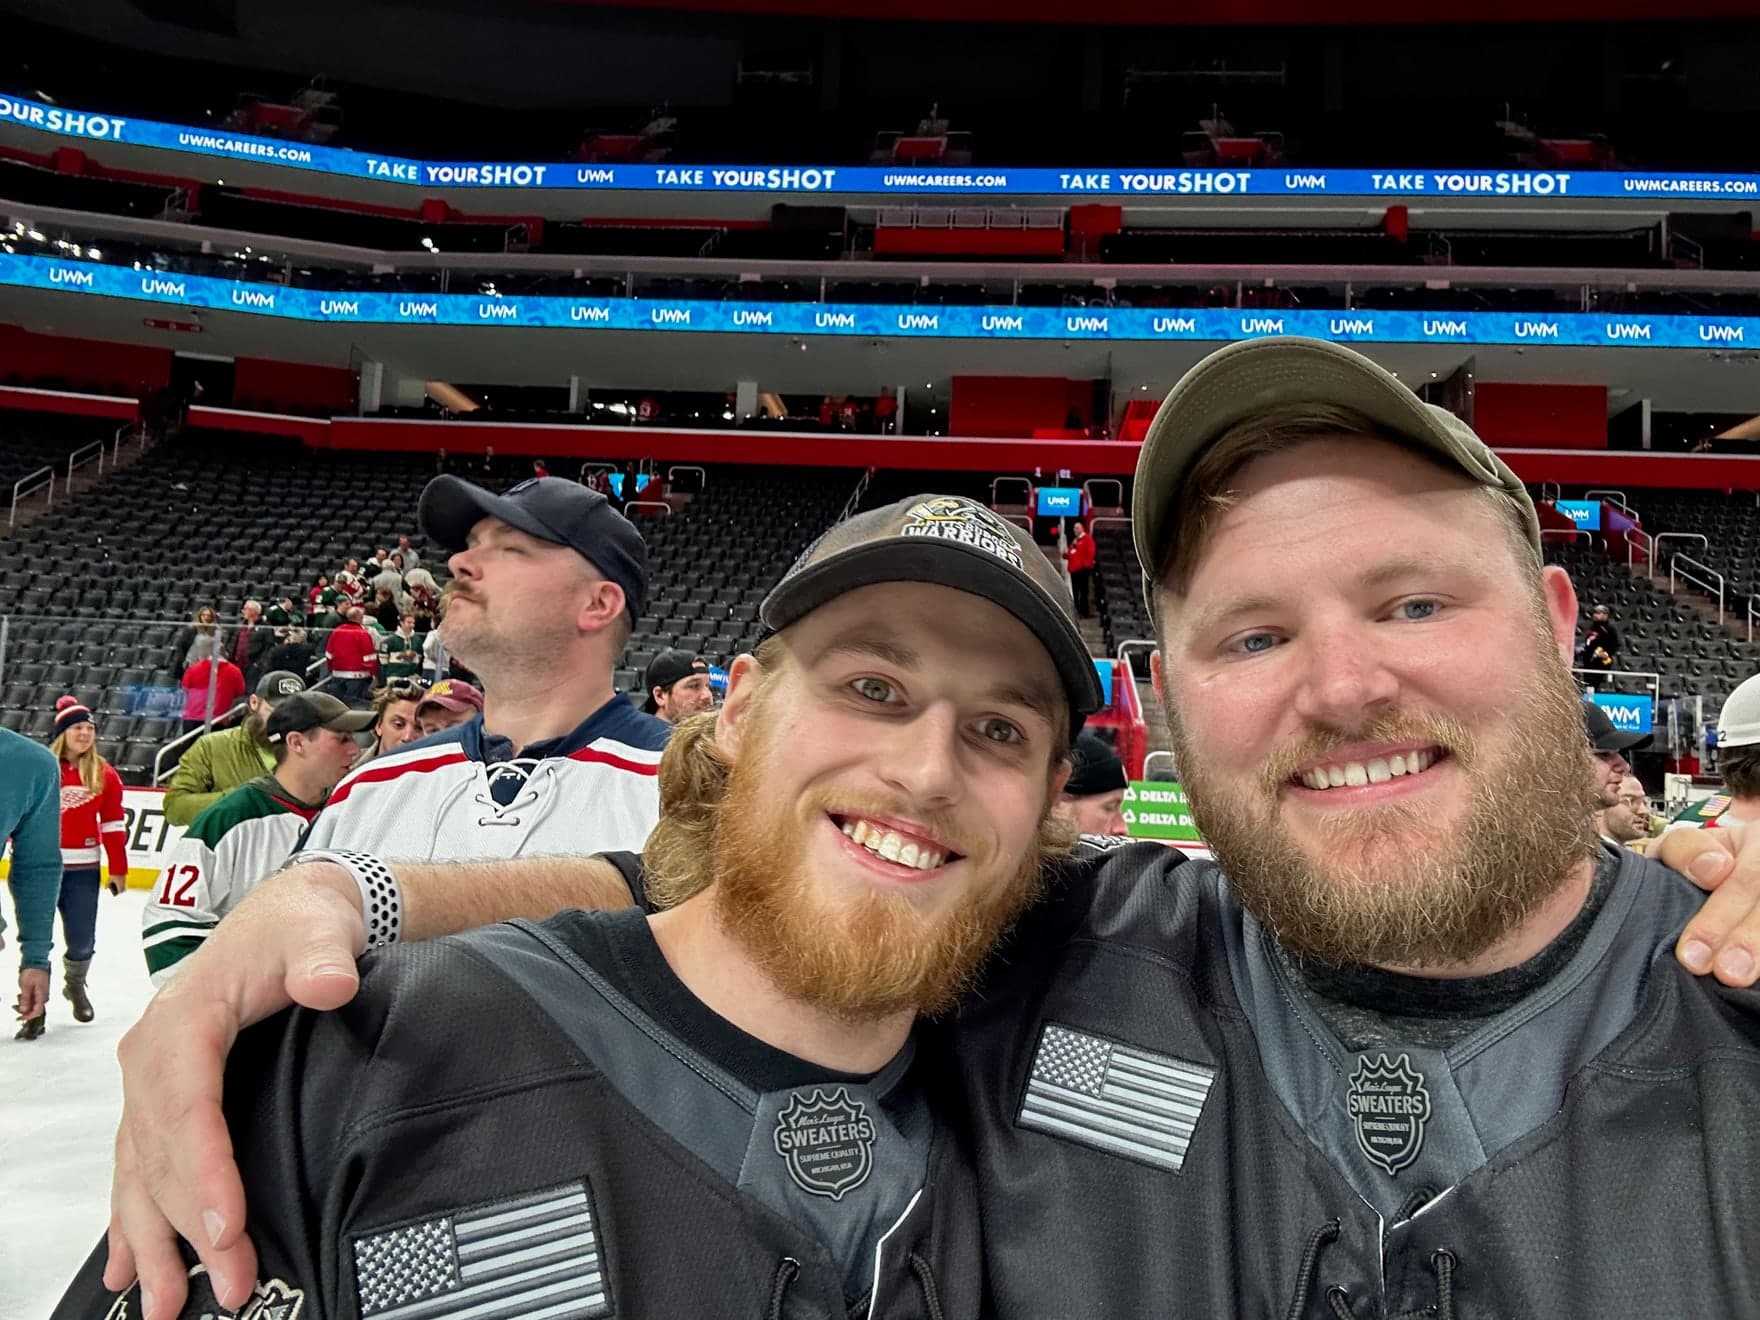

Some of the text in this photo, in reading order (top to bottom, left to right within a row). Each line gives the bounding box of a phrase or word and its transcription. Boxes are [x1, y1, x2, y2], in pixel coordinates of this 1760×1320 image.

[179, 133, 312, 163] UWMCAREERS.COM
[367, 159, 417, 181] TAKE
[577, 169, 614, 183] UWM
[656, 169, 704, 186] TAKE
[884, 175, 1007, 188] UWMCAREERS.COM
[1060, 174, 1110, 190] TAKE
[1285, 174, 1325, 189] UWM
[1372, 174, 1424, 191] TAKE
[1624, 179, 1758, 194] UWMCAREERS.COM
[49, 268, 93, 286] UWM
[141, 278, 185, 297] UWM
[232, 290, 274, 308] UWM
[320, 300, 358, 314] UWM
[399, 302, 437, 316] UWM
[479, 304, 517, 318] UWM
[571, 307, 609, 321] UWM
[652, 309, 690, 323] UWM
[733, 311, 772, 325] UWM
[815, 313, 855, 327] UWM
[898, 315, 938, 329] UWM
[982, 316, 1022, 330] UWM
[1067, 317, 1108, 332] UWM
[1153, 318, 1195, 332] UWM
[1240, 318, 1283, 333] UWM
[1330, 319, 1373, 334] UWM
[1423, 320, 1466, 336] UWM
[1514, 322, 1558, 337] UWM
[1606, 324, 1651, 339] UWM
[1699, 325, 1743, 341] UWM
[908, 525, 1019, 569] WARRIORS
[1139, 789, 1178, 804] DELTA
[1138, 812, 1178, 826] DELTA
[159, 863, 200, 908] 12
[1350, 1094, 1424, 1114] SWEATERS
[779, 1121, 870, 1149] SWEATERS
